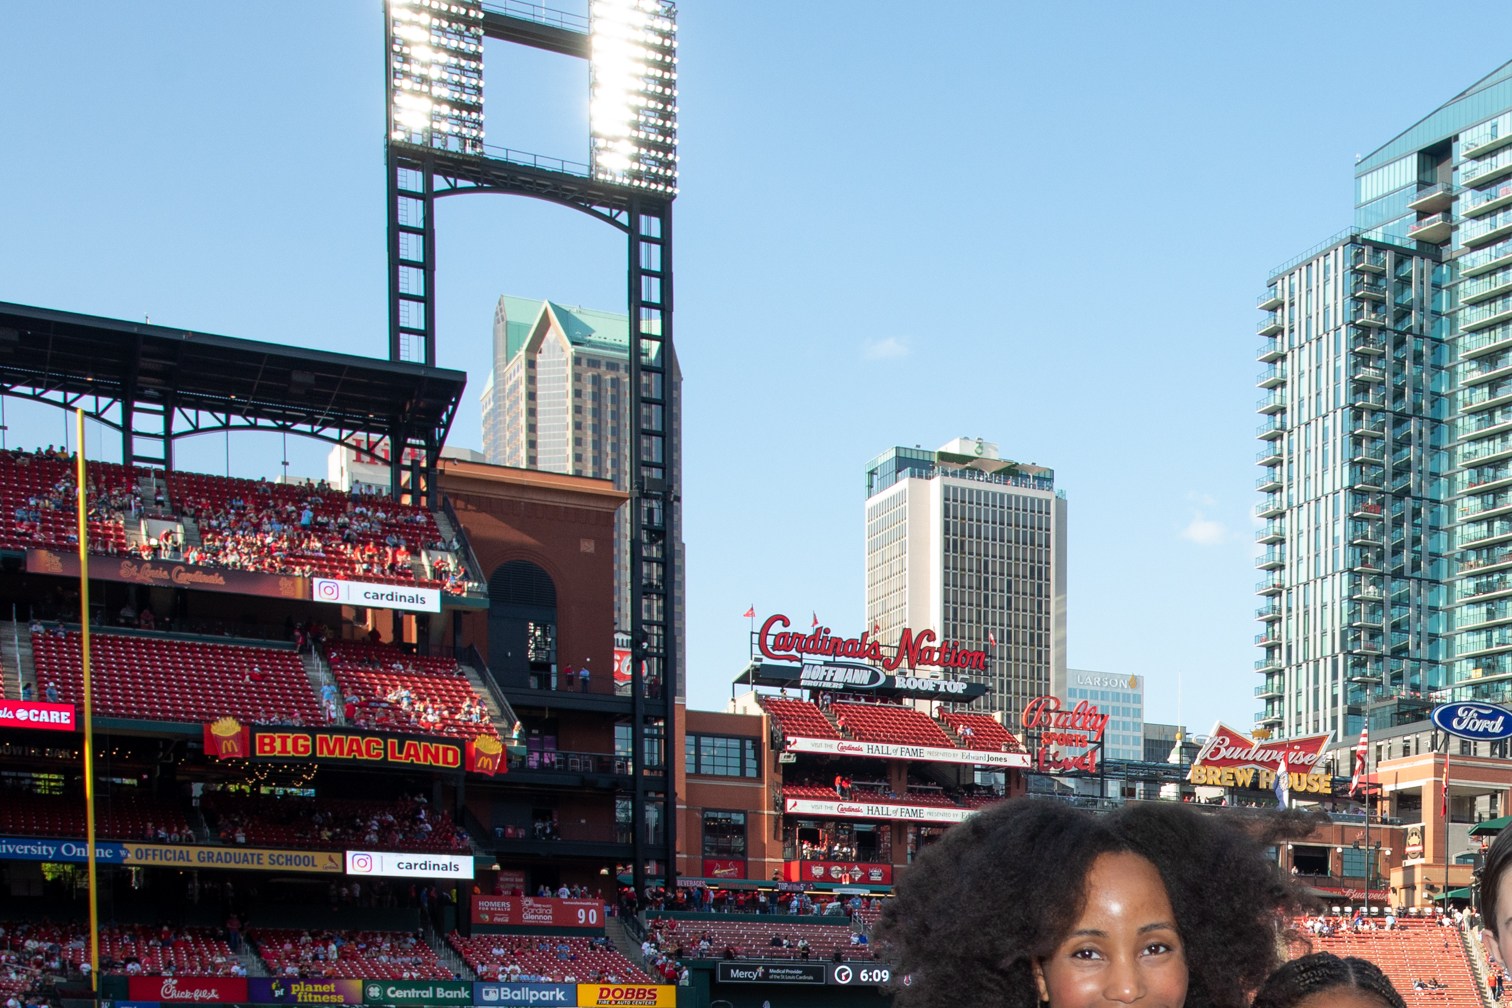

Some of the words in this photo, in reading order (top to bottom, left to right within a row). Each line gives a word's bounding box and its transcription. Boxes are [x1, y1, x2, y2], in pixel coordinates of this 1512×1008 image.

[172, 565, 226, 585] Cardinals
[364, 588, 426, 605] cardinals
[758, 614, 883, 662] Cardinals
[884, 628, 987, 671] Nation
[801, 663, 871, 685] HOFFMANN
[1077, 674, 1127, 689] LARSON
[801, 680, 845, 689] BROTHERS
[895, 676, 967, 694] ROOFTOP
[29, 709, 71, 724] CARE
[1022, 695, 1110, 741] Bally
[1452, 706, 1504, 733] Ford
[1041, 731, 1088, 748] SPORTS
[255, 732, 312, 757] BIG
[316, 734, 383, 760] MAC
[388, 738, 461, 768] LAND
[837, 742, 863, 752] Cardinals
[867, 745, 892, 755] HALL
[892, 748, 899, 756] of
[900, 747, 925, 758] FAME
[1191, 764, 1255, 788] BREW
[1259, 770, 1332, 794] HUSE
[837, 804, 863, 814] Cardinals
[867, 806, 892, 817] HALL
[900, 807, 925, 819] FAME
[61, 842, 113, 858] Onlne
[135, 848, 194, 864] OFFICIAL
[197, 849, 264, 866] GRADUATE
[268, 852, 318, 867] SCHOOL
[396, 860, 460, 873] cardinals
[676, 879, 706, 887] BEVERAGES
[522, 907, 553, 915] Cardinal
[730, 969, 758, 980] Mercy
[859, 970, 890, 982] 6:09
[291, 982, 335, 996] planet
[387, 986, 433, 999] Central
[436, 988, 470, 999] Bank
[500, 988, 565, 1003] Ballpark
[598, 987, 657, 1000] DOBBS
[297, 993, 344, 1003] fitness
